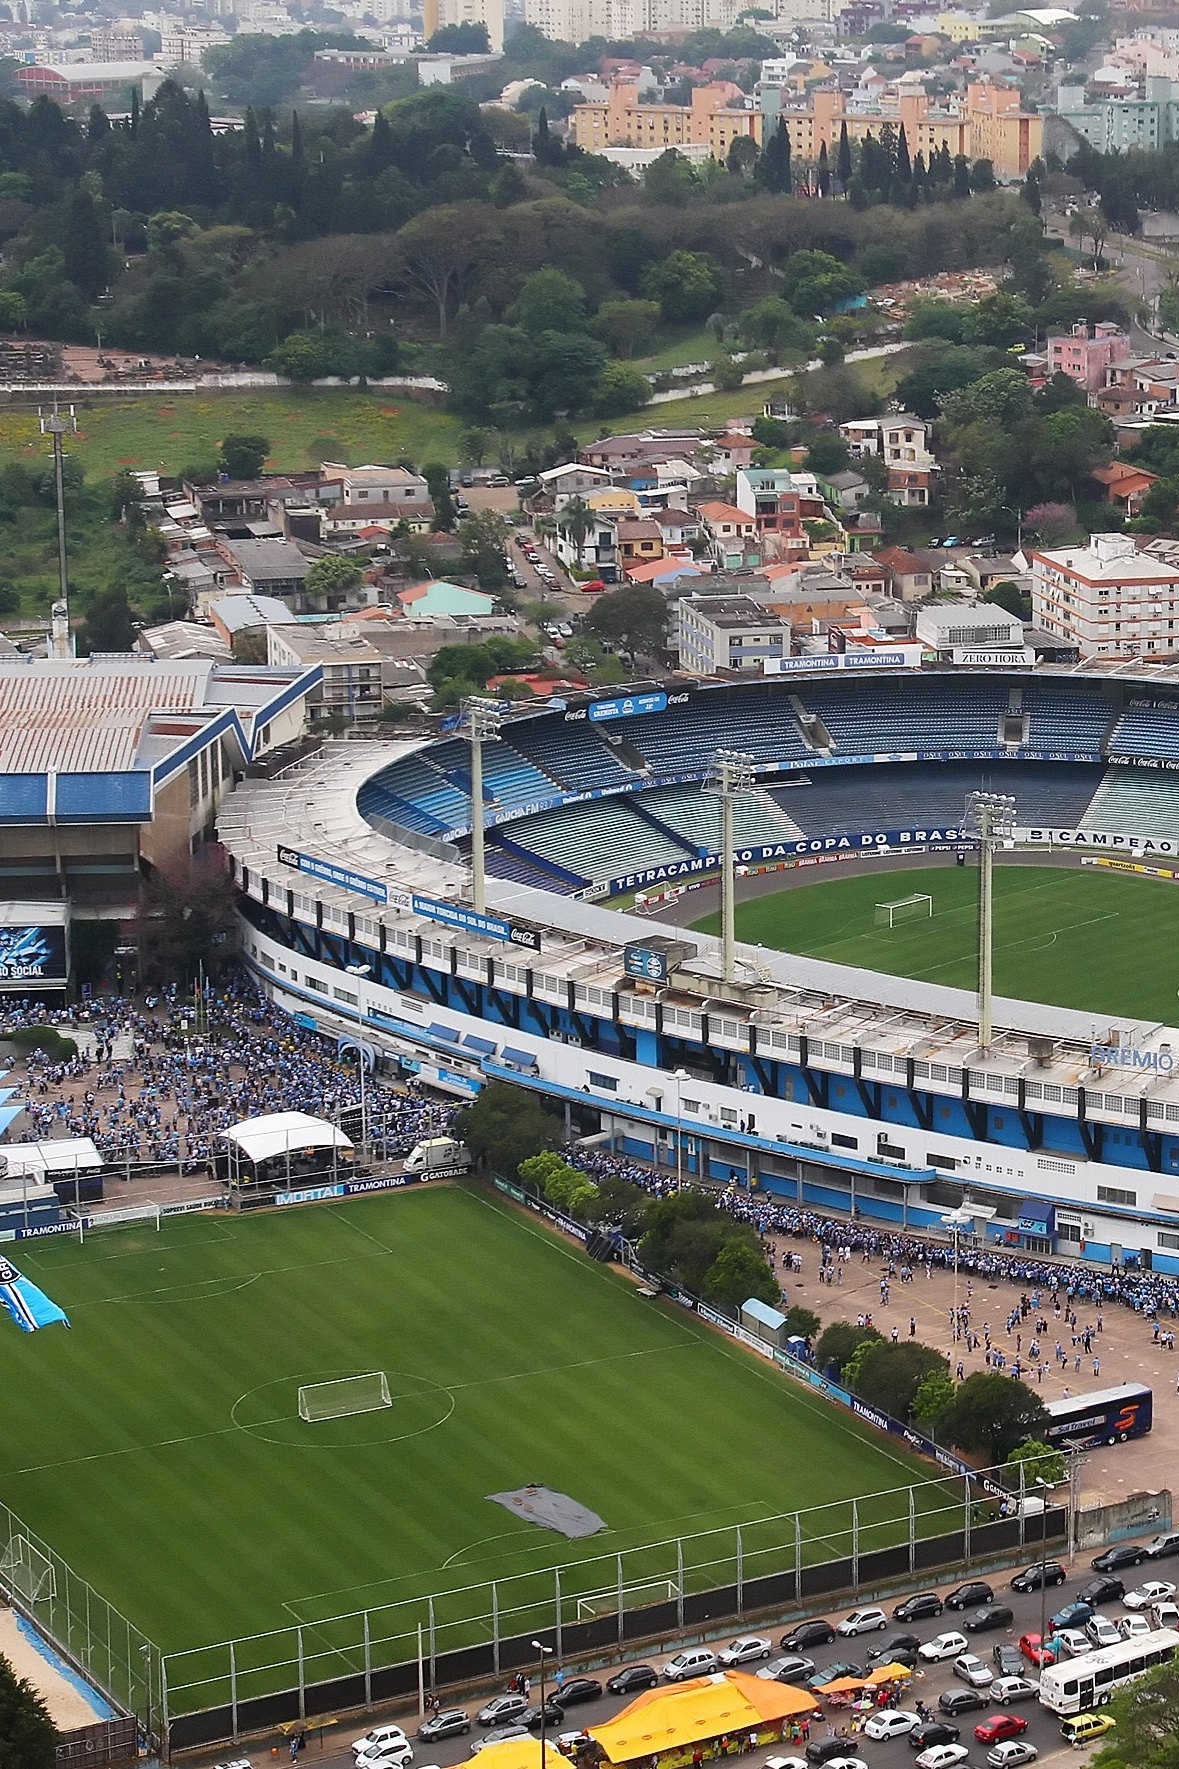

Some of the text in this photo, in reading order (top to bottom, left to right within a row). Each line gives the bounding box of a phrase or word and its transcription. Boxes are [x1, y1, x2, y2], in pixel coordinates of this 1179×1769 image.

[784, 656, 901, 669] TRAMONTINA TRAMONTINA
[962, 652, 1026, 664] ZERO HORA
[602, 786, 624, 796] Unimed
[763, 845, 786, 858] DA
[796, 838, 850, 853] COPA
[862, 833, 887, 845] DO
[280, 848, 298, 866] Coca-Cola
[1108, 861, 1135, 870] quartzolit
[510, 928, 535, 945] Coca-Cola
[10, 966, 44, 976] SOCIAL
[1092, 1044, 1173, 1070] GRÊMIO
[429, 1168, 468, 1179] GATORADE
[349, 1177, 405, 1193] TRAMONTINA
[276, 1187, 344, 1206] IMORTAL
[21, 1220, 82, 1238] TRAMONTINA
[556, 1218, 586, 1241] TRAMONTINA
[854, 1401, 888, 1430] TRAMONTINA
[1071, 1418, 1095, 1430] Travel
